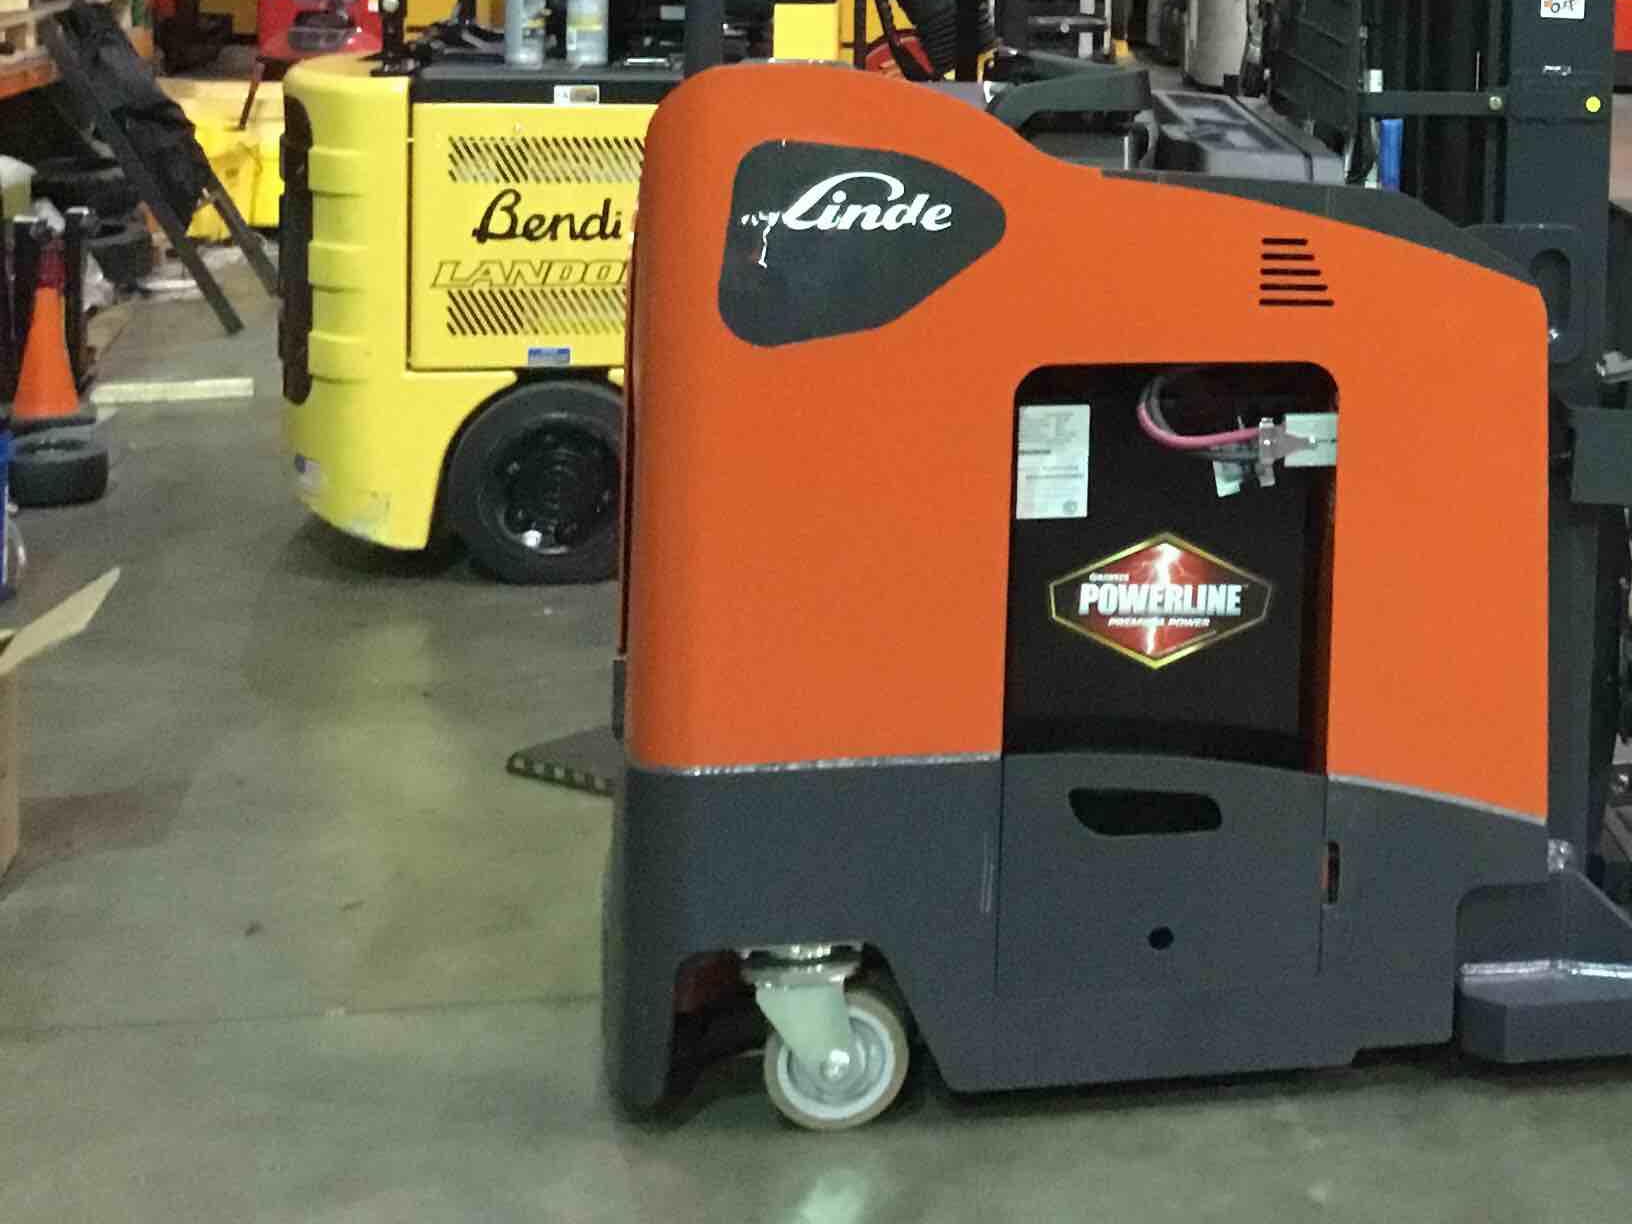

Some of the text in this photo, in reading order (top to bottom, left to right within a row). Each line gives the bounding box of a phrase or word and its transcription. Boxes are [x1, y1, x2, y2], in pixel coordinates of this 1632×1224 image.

[471, 188, 622, 244] Bendi
[740, 171, 954, 232] Linde
[430, 258, 628, 289] LANDO
[1078, 583, 1242, 616] POWERLINE
